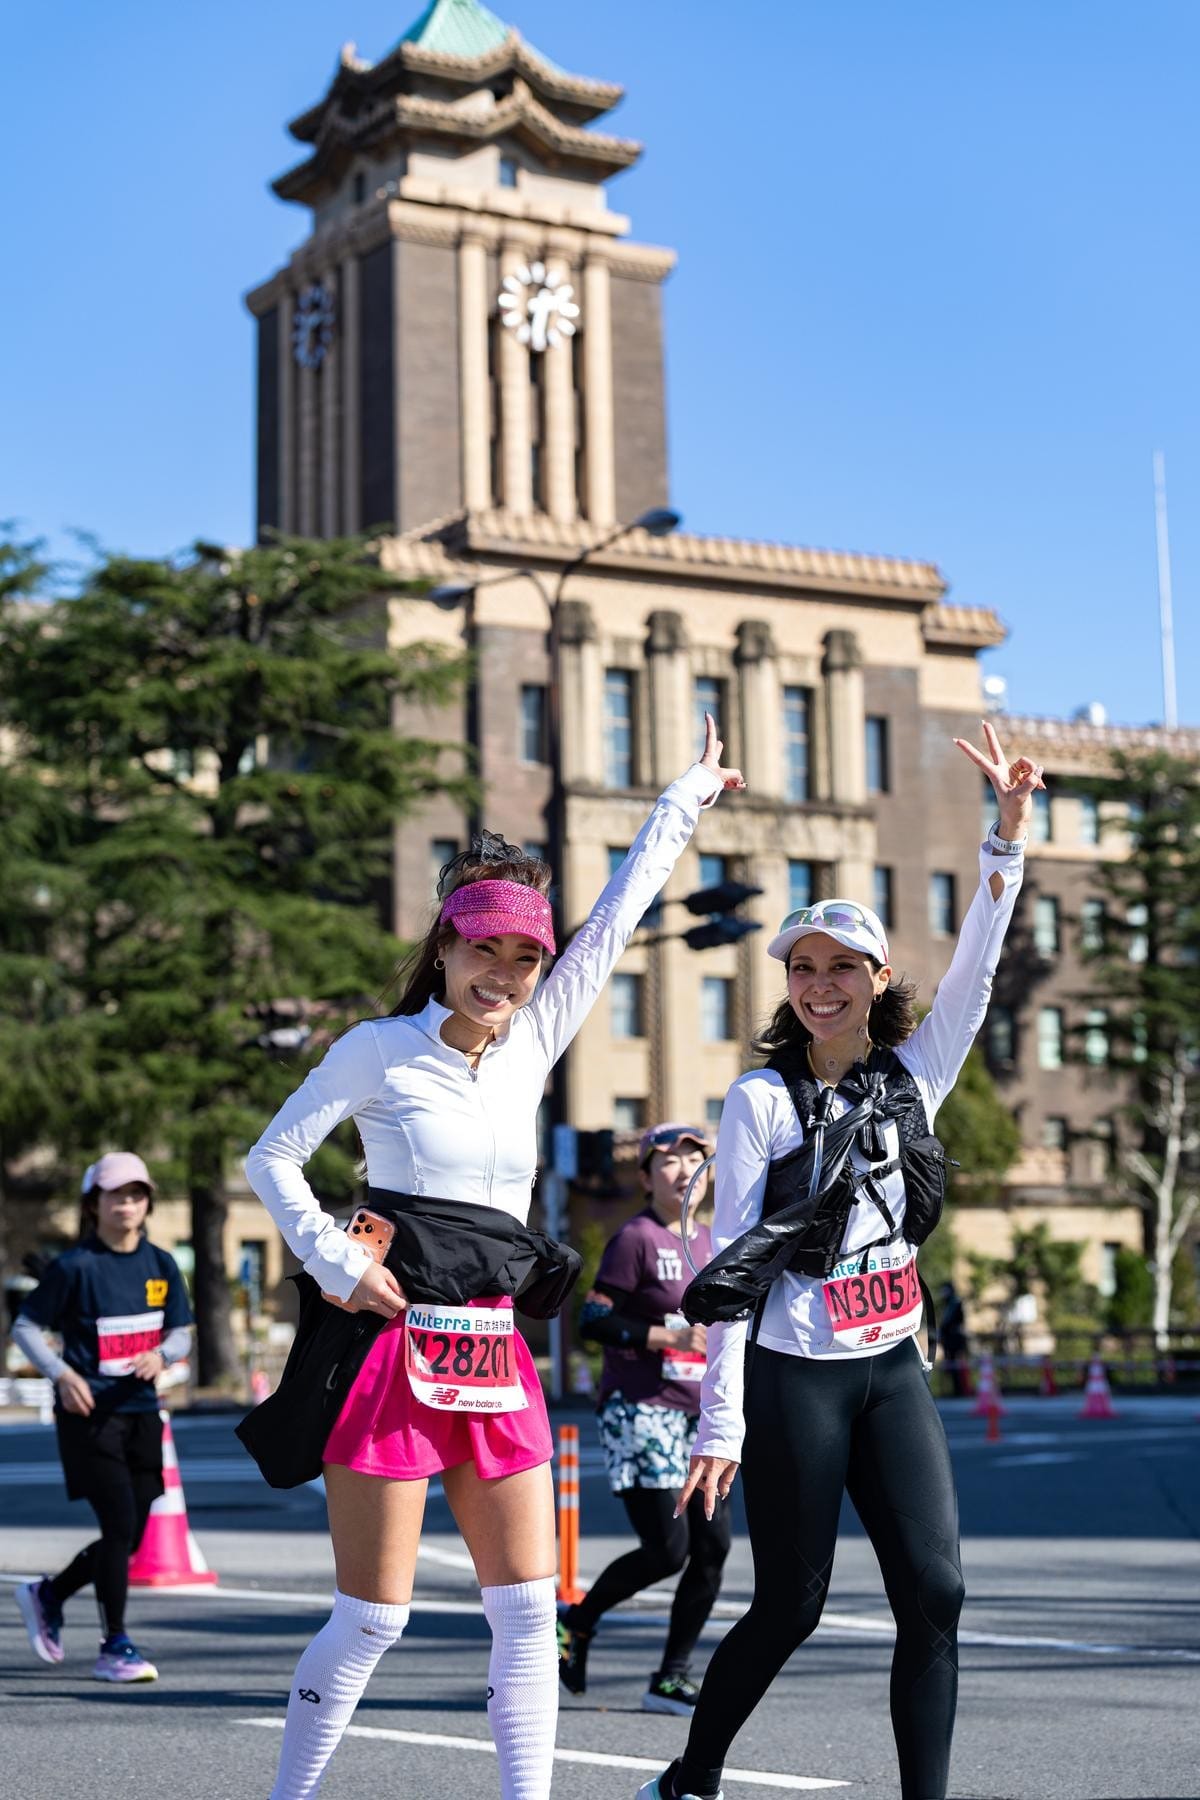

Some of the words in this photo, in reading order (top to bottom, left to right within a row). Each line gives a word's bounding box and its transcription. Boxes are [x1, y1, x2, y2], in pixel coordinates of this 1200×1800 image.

[824, 1259, 877, 1282] Nitera
[408, 1310, 471, 1331] Niterra
[881, 1331, 896, 1341] new
[458, 1400, 475, 1408] new
